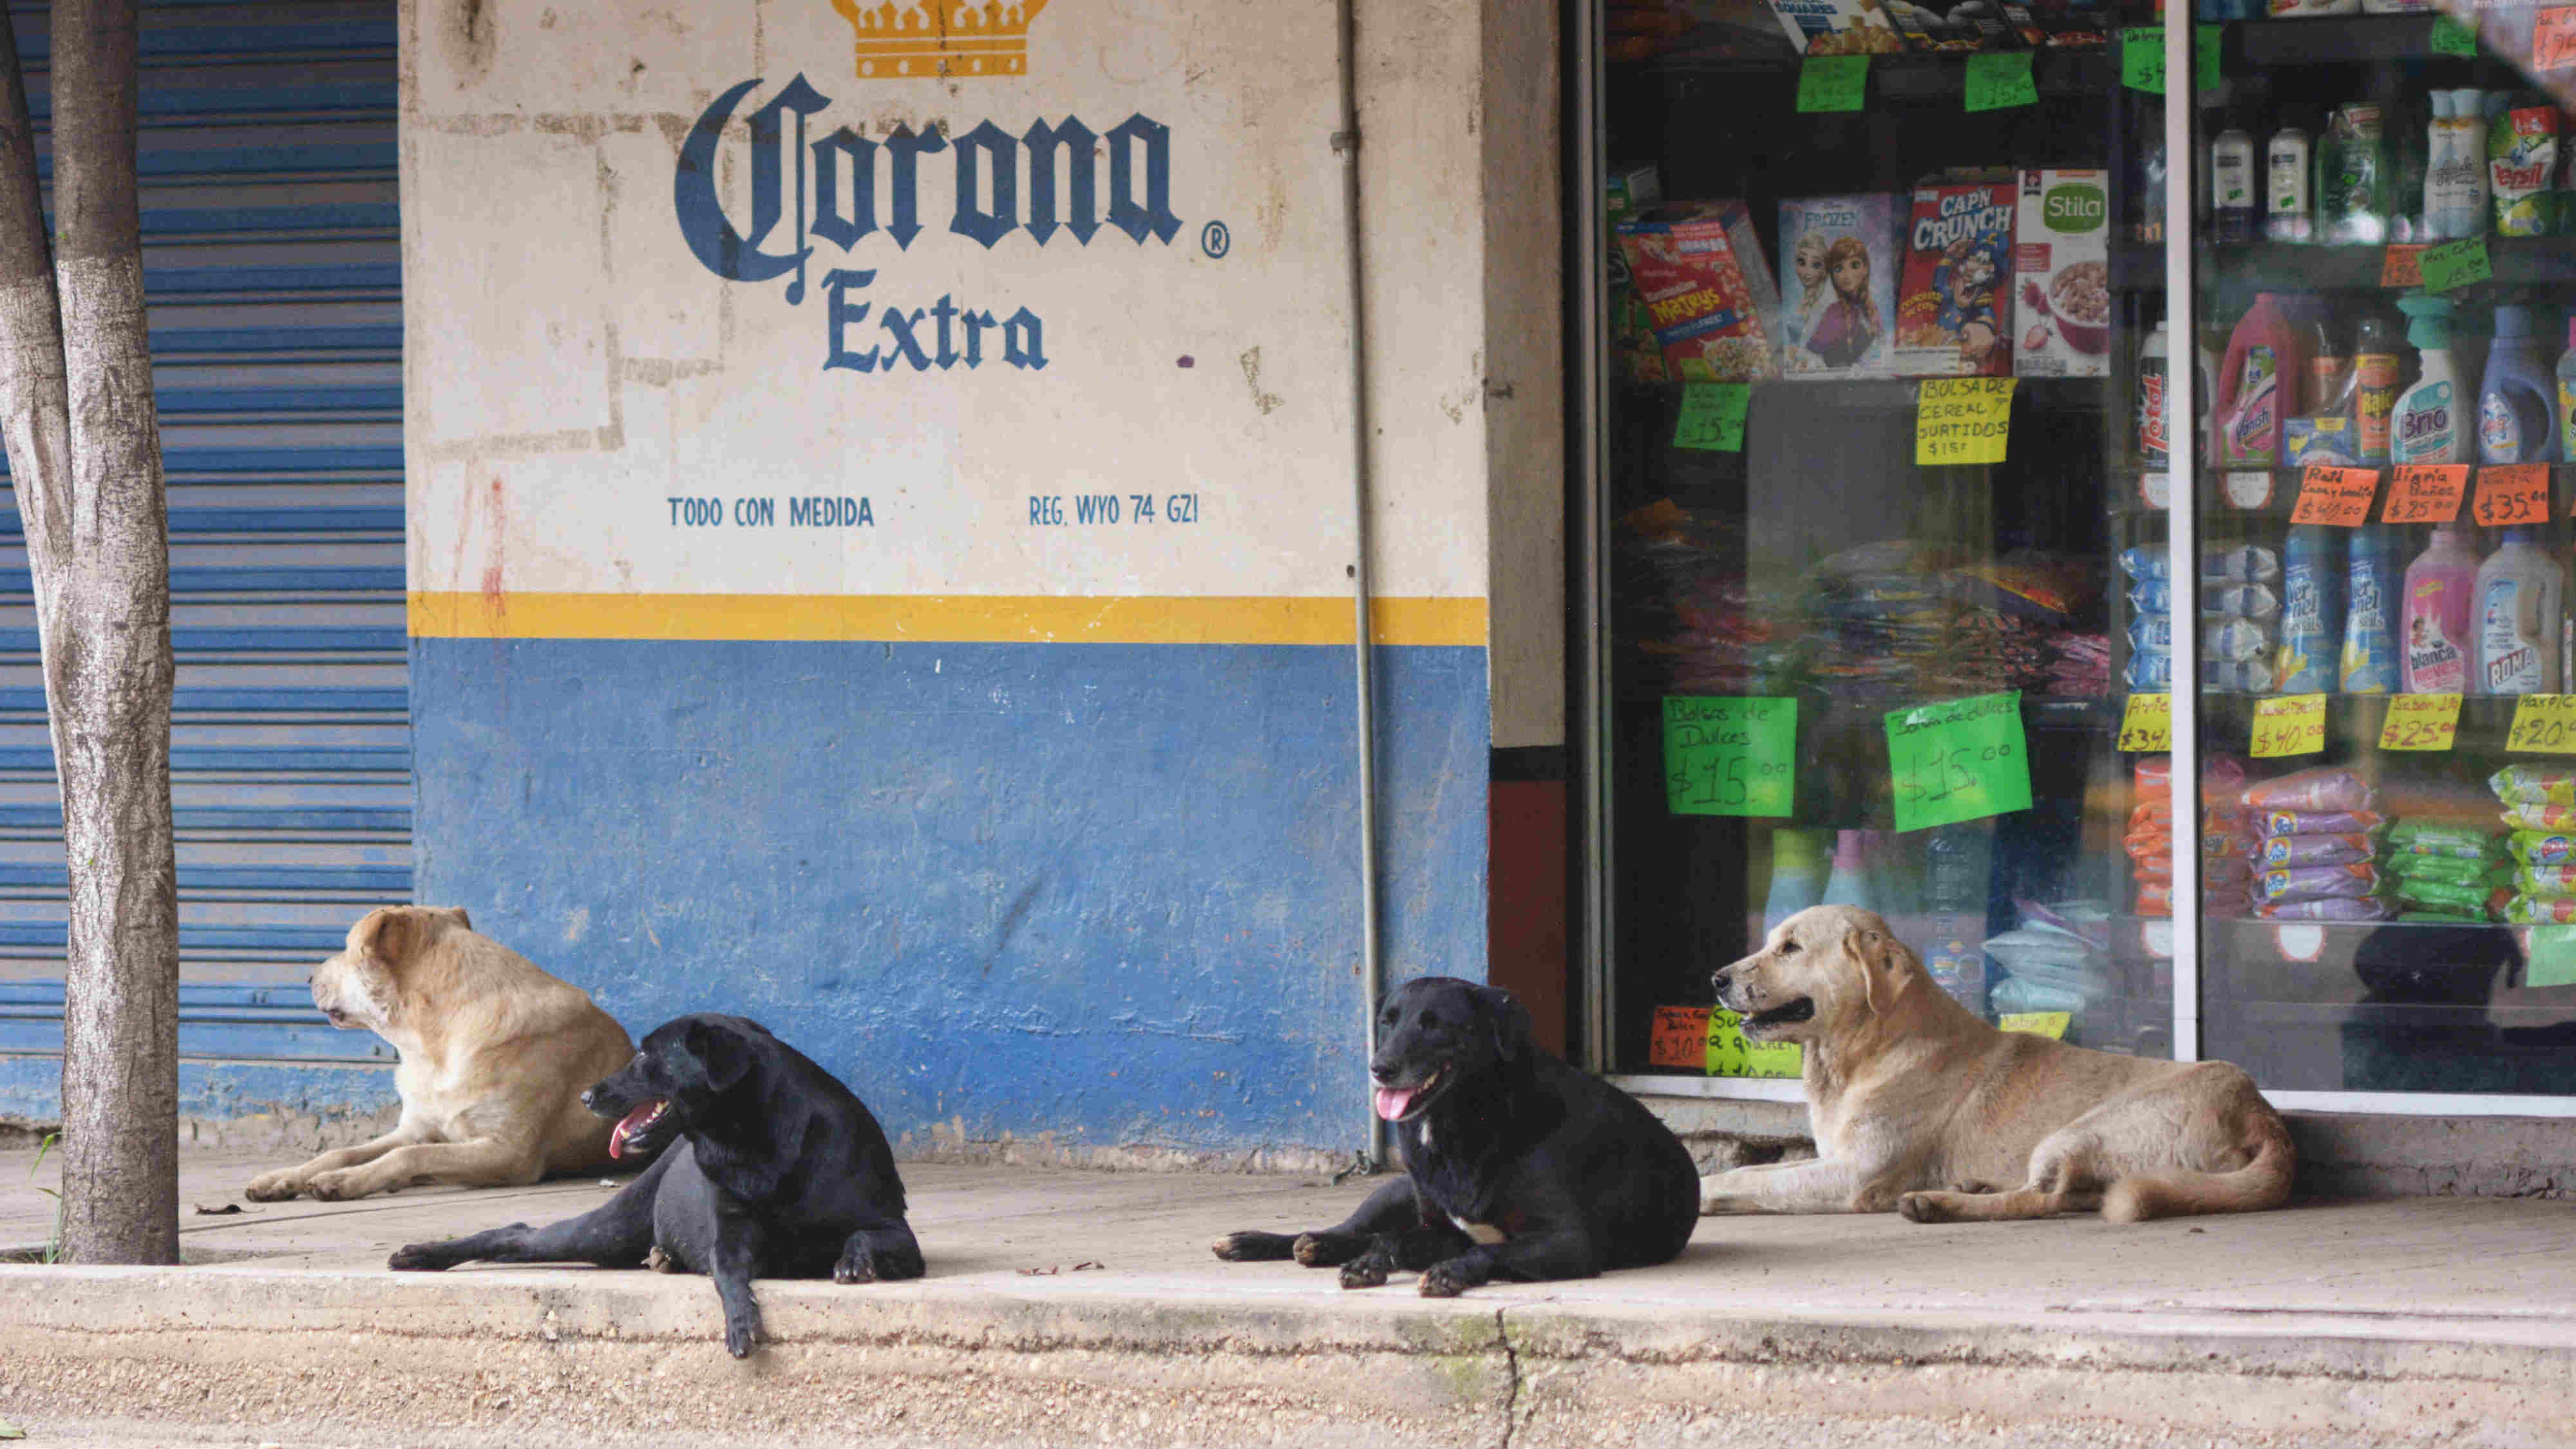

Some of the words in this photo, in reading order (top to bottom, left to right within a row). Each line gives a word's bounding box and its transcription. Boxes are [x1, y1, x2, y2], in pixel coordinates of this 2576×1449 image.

[674, 71, 1184, 305] Corona
[2049, 195, 2102, 217] Stila
[1913, 205, 2014, 251] CRUNCH
[822, 268, 1049, 373] Extra
[1920, 402, 1988, 420] CEREAL
[2140, 373, 2168, 453] Total
[2235, 407, 2270, 444] Vanish
[1918, 421, 2008, 439] SURTIDOS
[667, 497, 723, 526] TODO
[735, 497, 774, 526] CON
[790, 496, 875, 527] MEDIDA
[1129, 493, 1155, 524] 74
[2410, 645, 2458, 670] blanca
[2487, 647, 2536, 688] ROMA
[2126, 696, 2169, 717] Arie
[1677, 724, 1752, 748] Dulces
